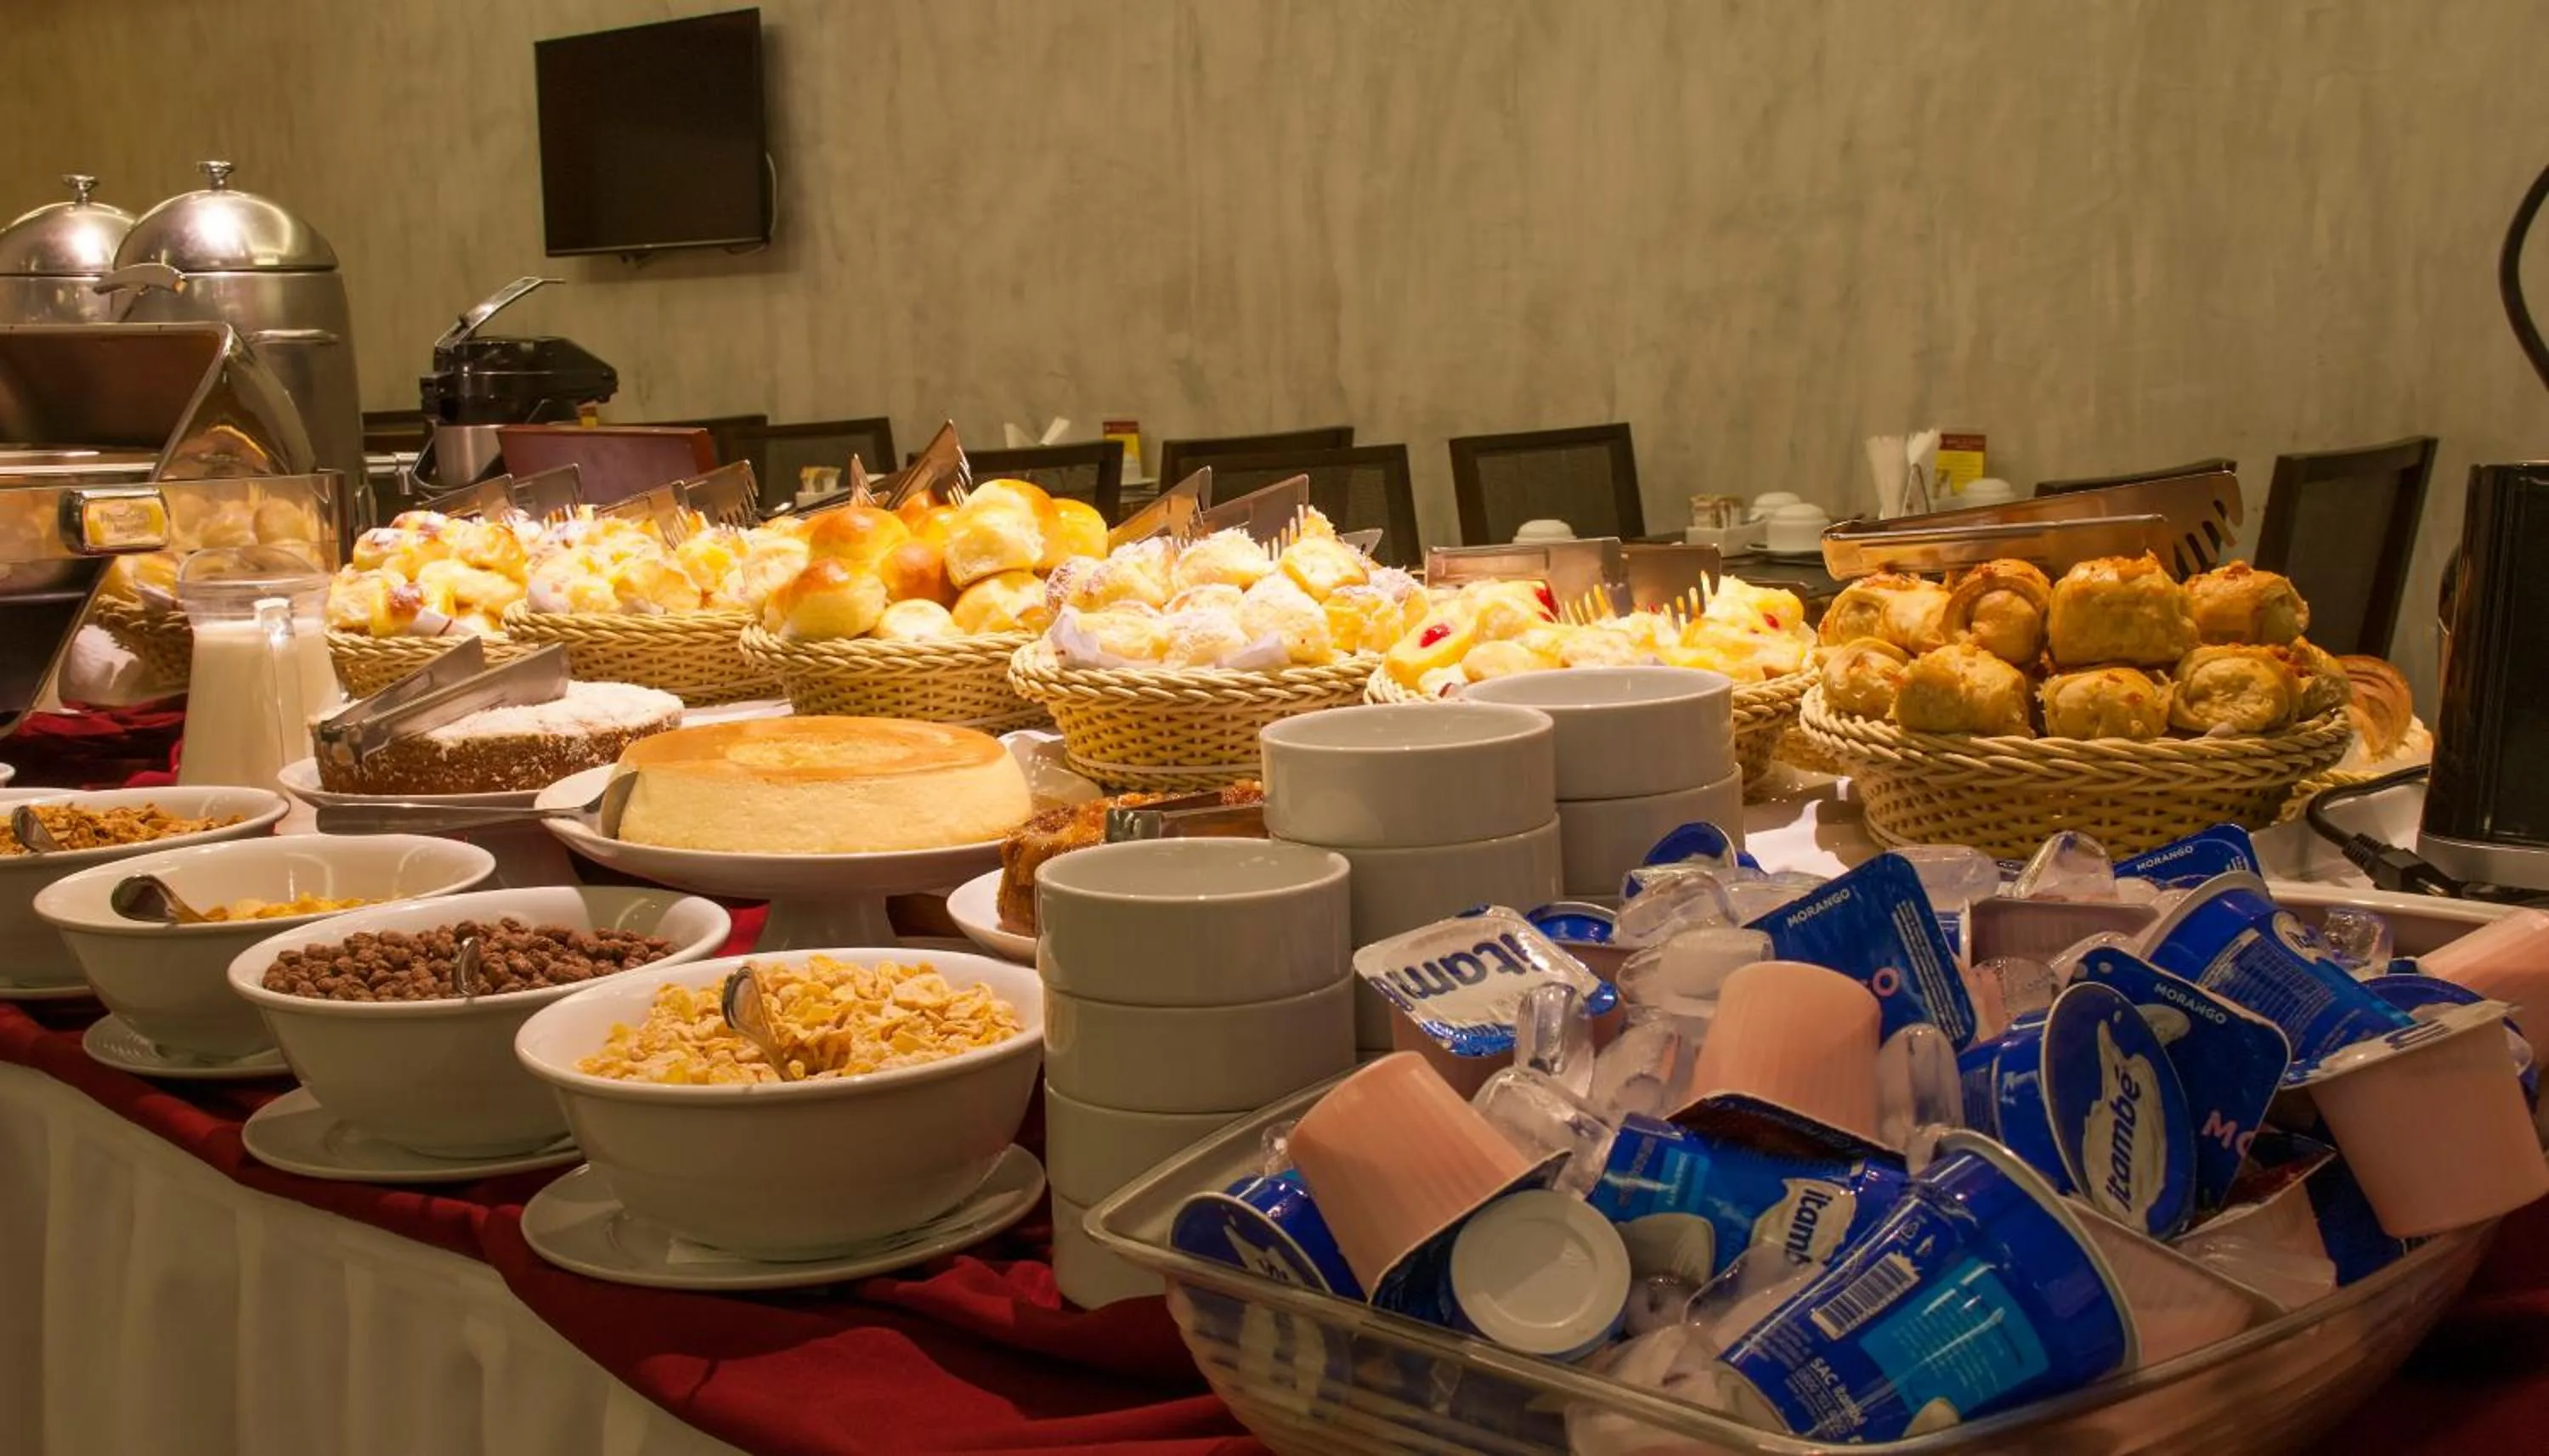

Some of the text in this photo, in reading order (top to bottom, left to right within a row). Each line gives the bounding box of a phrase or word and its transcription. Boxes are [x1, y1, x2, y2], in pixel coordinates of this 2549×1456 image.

[2136, 845, 2194, 871] MORANGO
[1787, 888, 1851, 928] MORANGO
[2153, 982, 2227, 1024] MORANGO
[1810, 1357, 1840, 1386] SAC
